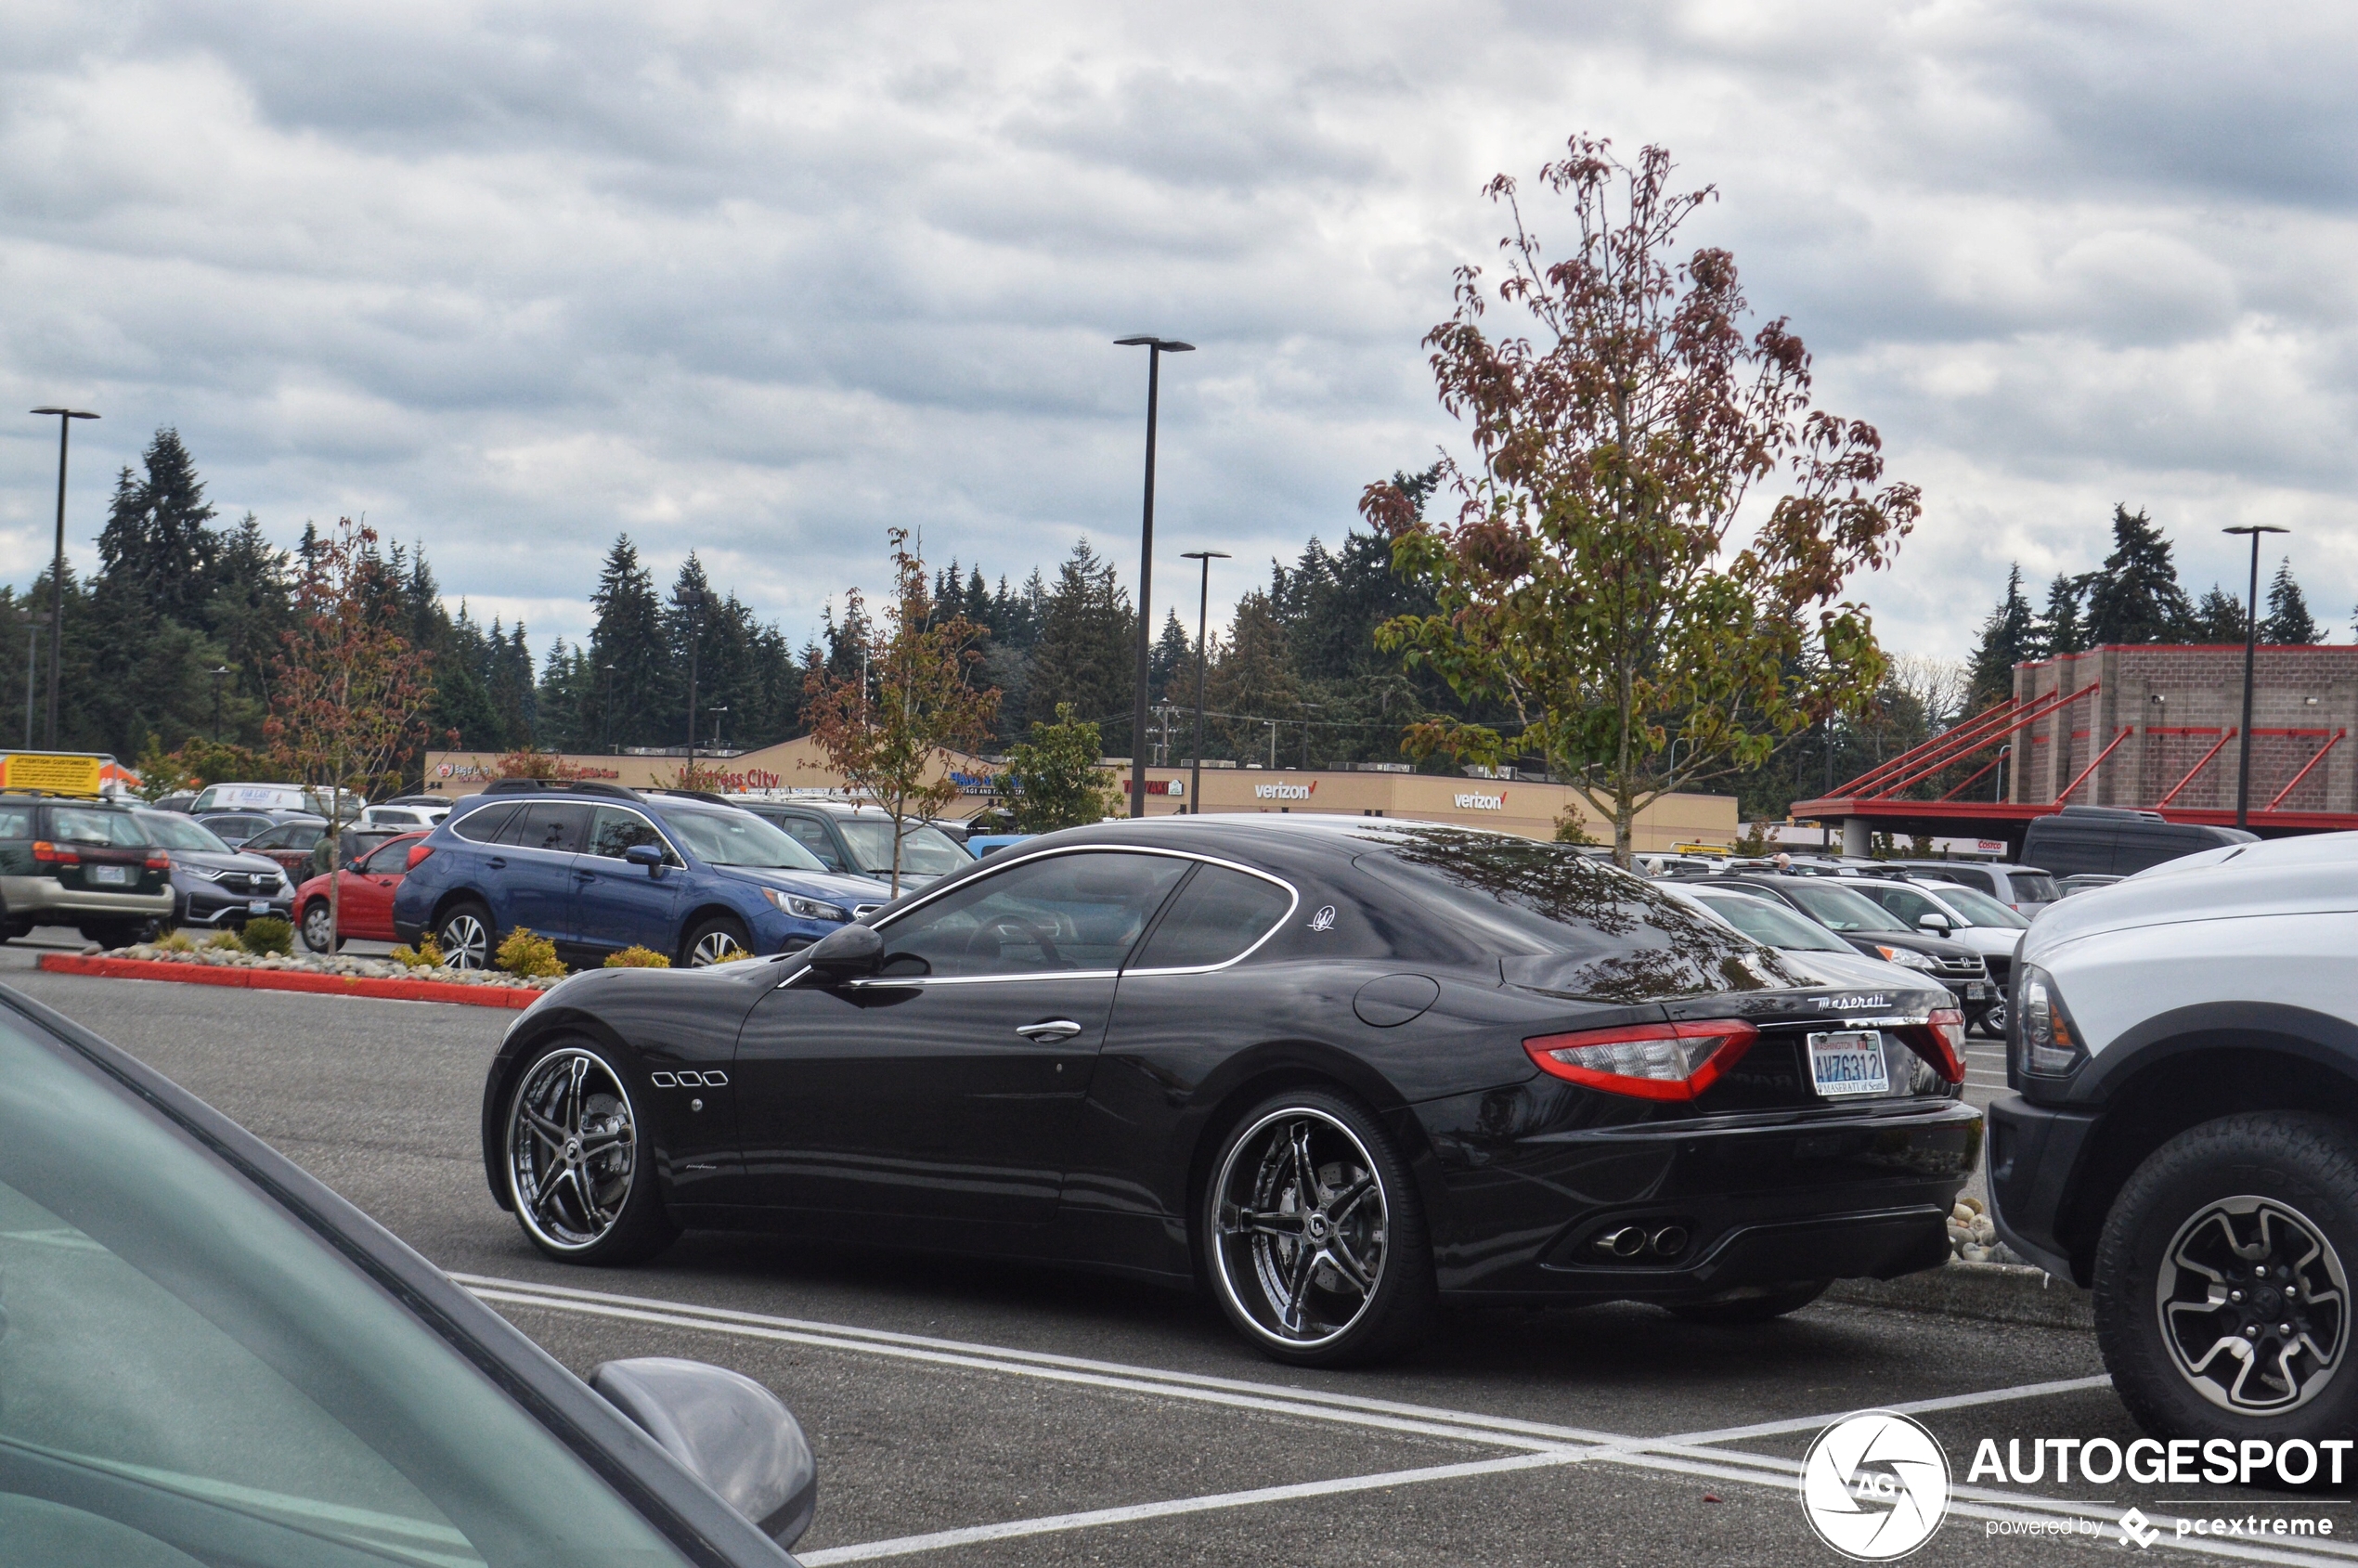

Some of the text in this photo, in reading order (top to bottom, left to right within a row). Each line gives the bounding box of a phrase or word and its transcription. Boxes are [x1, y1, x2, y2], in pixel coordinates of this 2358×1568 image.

[747, 769, 780, 788] City
[1122, 780, 1169, 796] TYAKI
[1255, 782, 1309, 799] verizon
[1454, 791, 1501, 810] verizon
[1807, 993, 1892, 1011] Maserati
[1814, 1042, 1853, 1050] WASHINGTON
[1816, 1054, 1880, 1082] AVZ6312
[1823, 1081, 1887, 1094] MASERATI of Seattle
